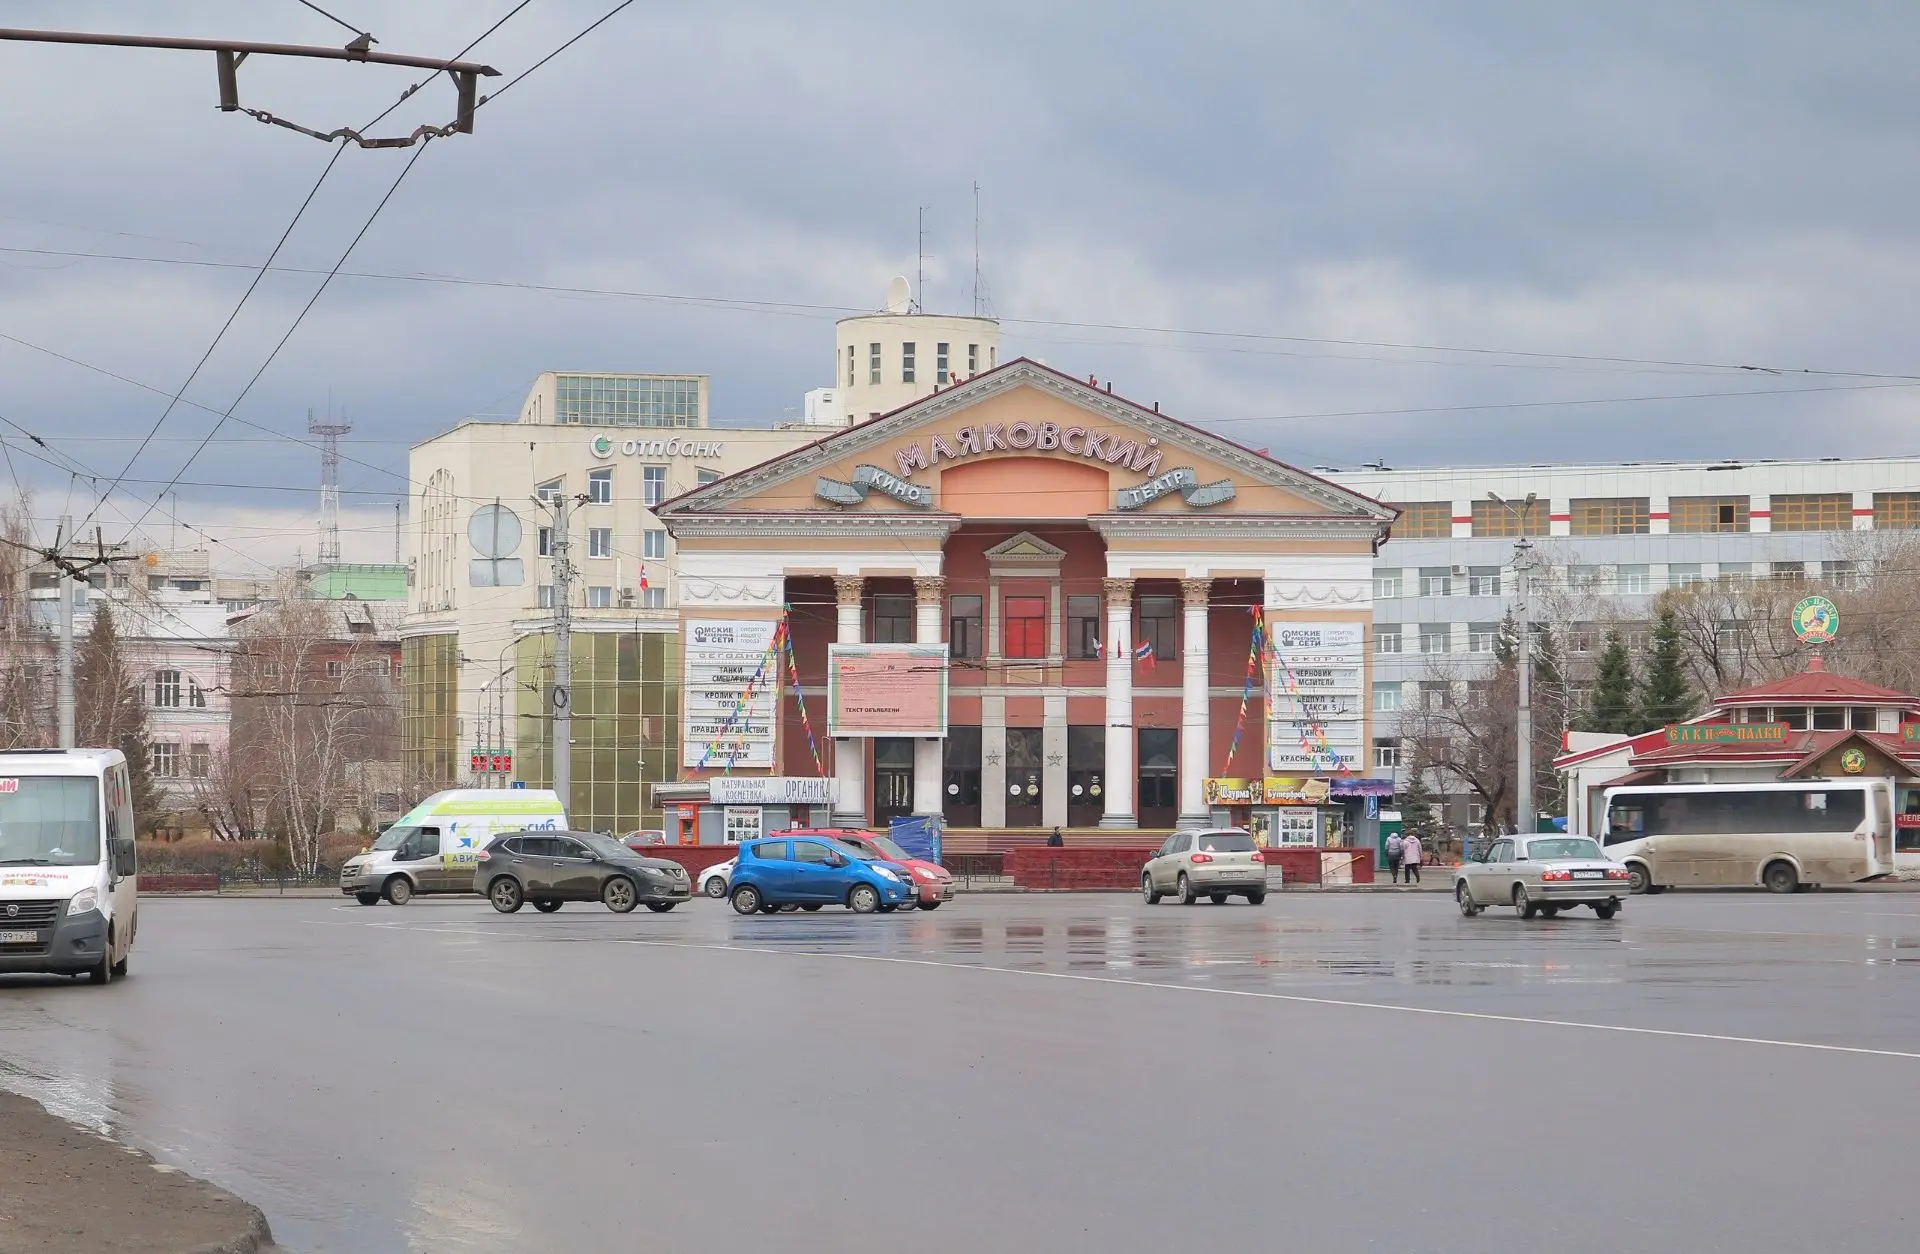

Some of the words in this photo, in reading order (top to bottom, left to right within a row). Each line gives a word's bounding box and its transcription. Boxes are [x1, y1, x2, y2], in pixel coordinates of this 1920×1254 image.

[621, 436, 723, 457] отпбанк
[895, 422, 1165, 477] МАЯКОВСКИЙ
[871, 470, 920, 501] КИНО
[1129, 471, 1184, 502] ТЕАТР
[719, 666, 743, 674] ТАНКИ
[704, 692, 733, 700] КРОЛИК
[735, 726, 769, 734] ДЕСТВИЕ
[708, 751, 749, 759] ЭМПЕДЖ
[1280, 754, 1316, 762] КРАСНЫ
[721, 780, 766, 788] НАТУРАЛЬНАЯ
[725, 790, 762, 799] КОСМЕТИКА
[785, 780, 831, 799] ОРГАНИКА
[1220, 784, 1250, 799] Шаурма
[1267, 789, 1306, 800] Бутерброд
